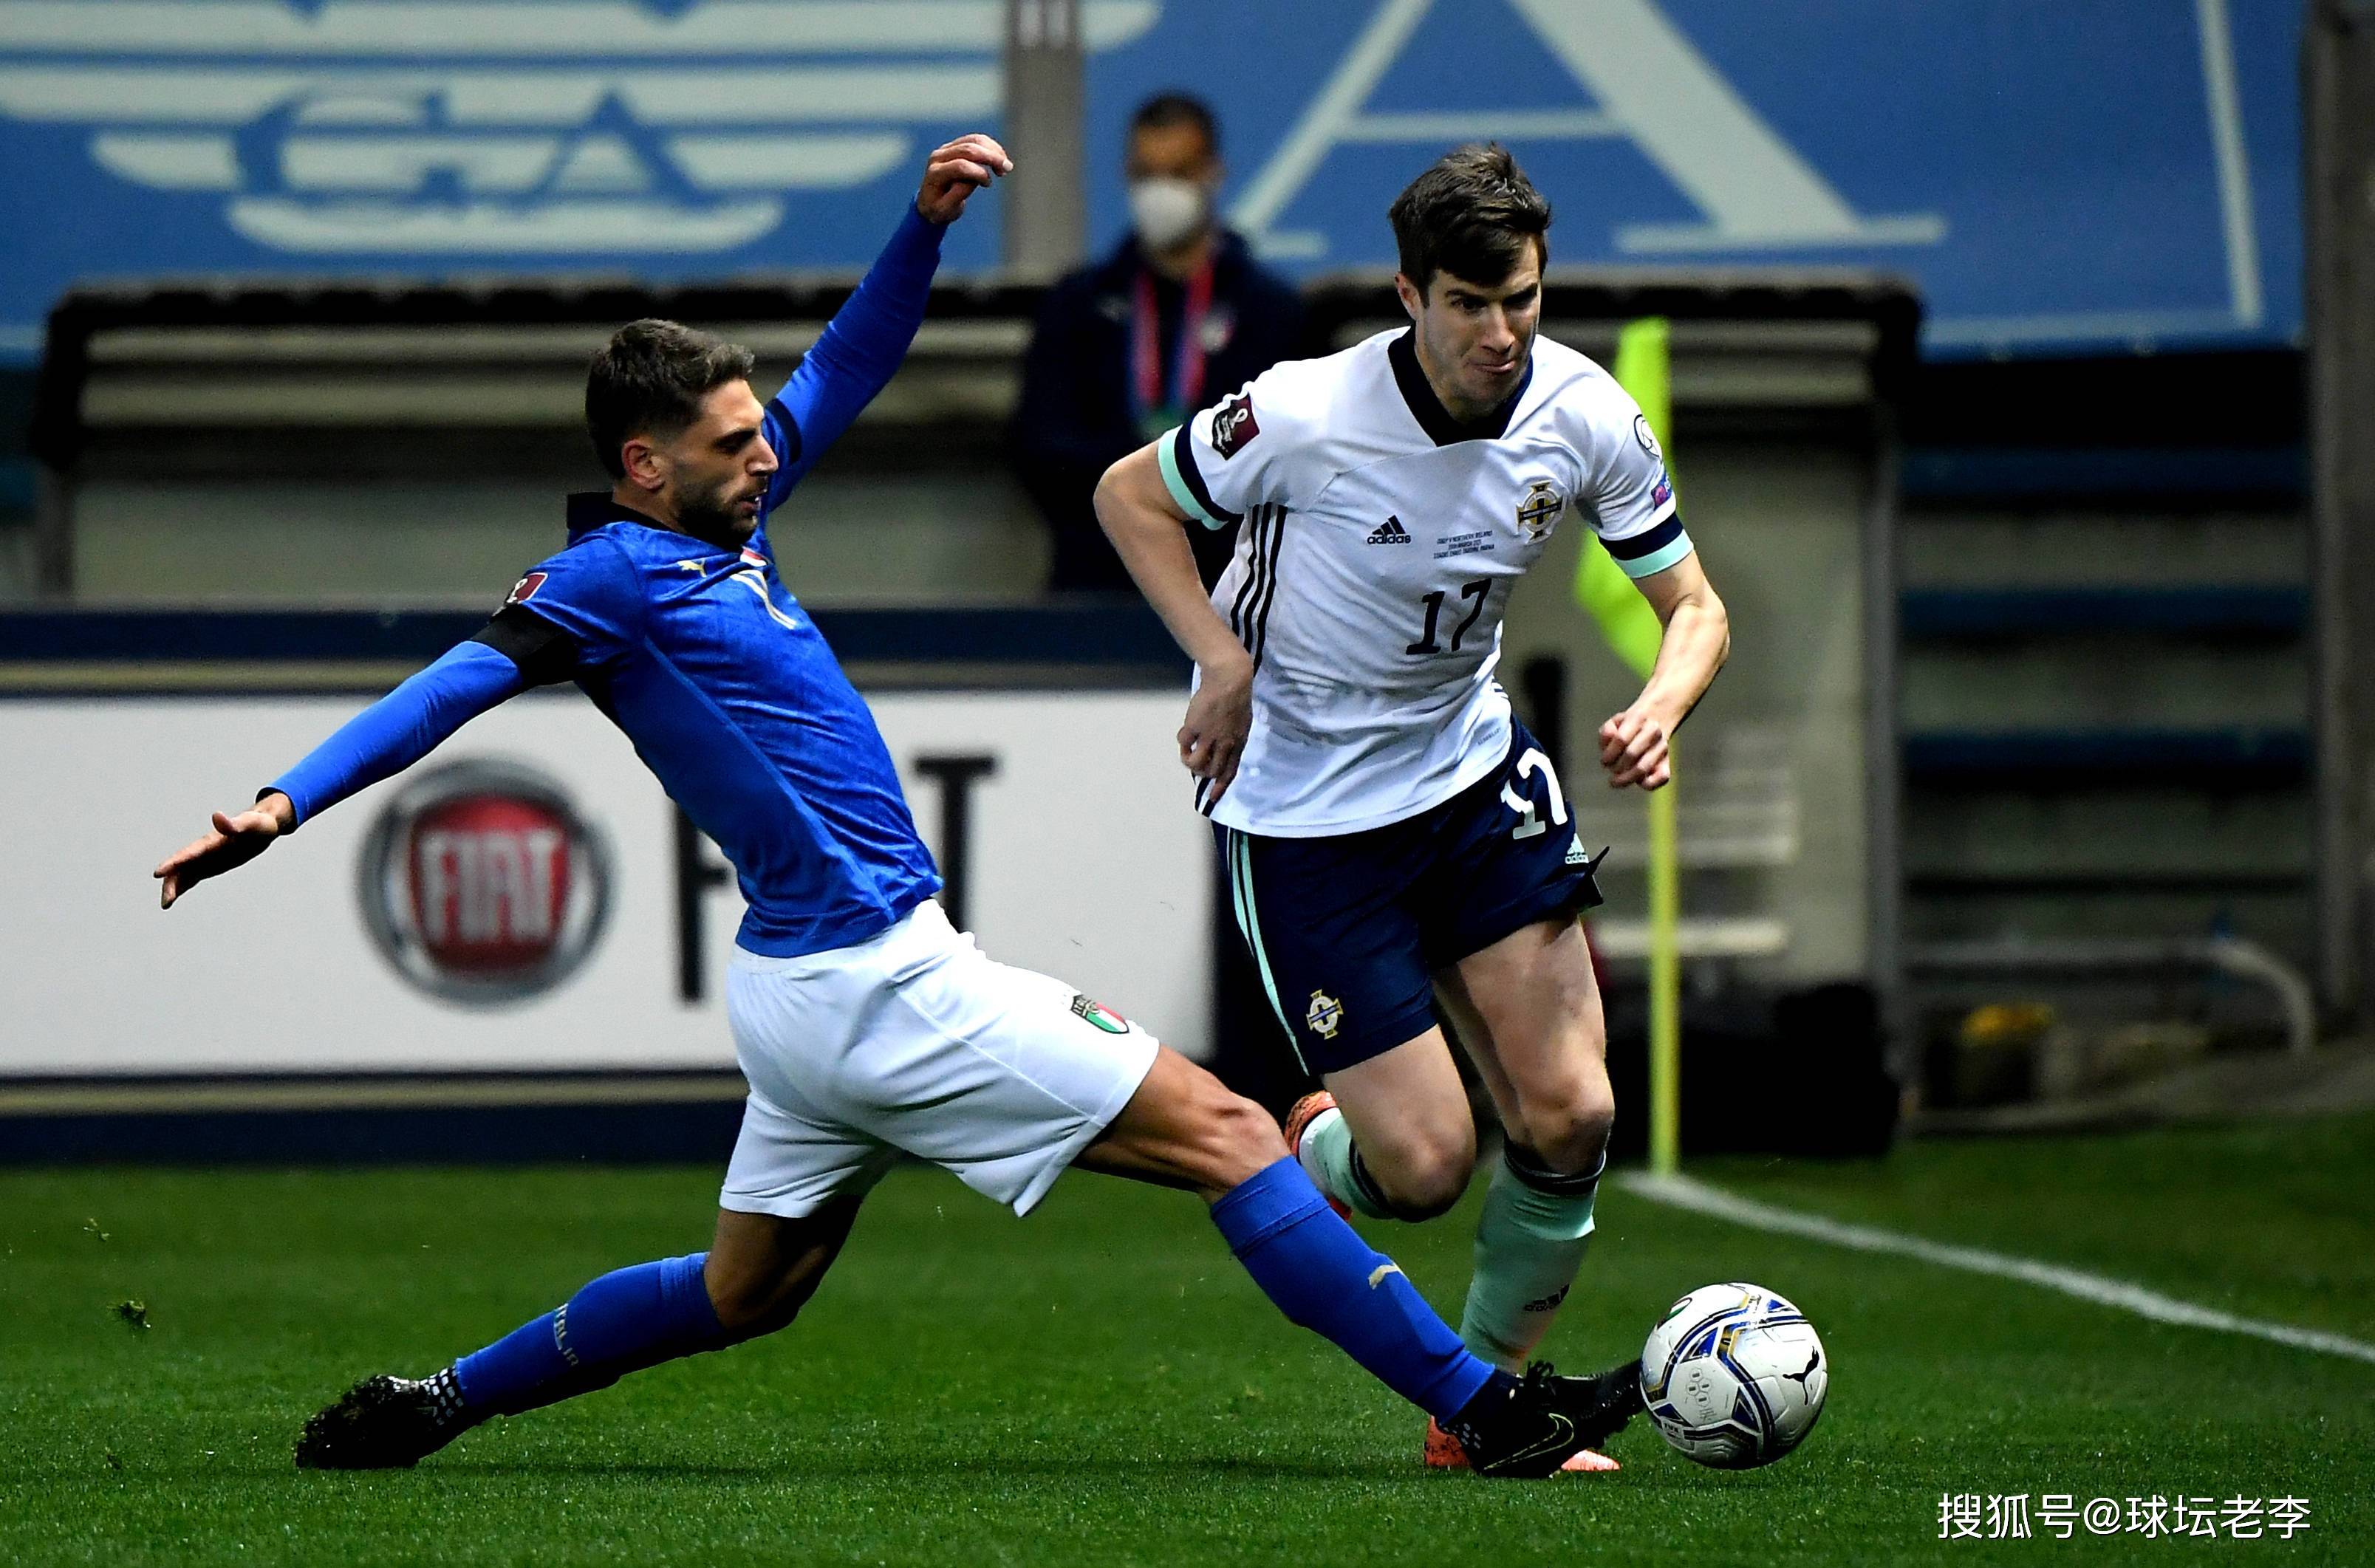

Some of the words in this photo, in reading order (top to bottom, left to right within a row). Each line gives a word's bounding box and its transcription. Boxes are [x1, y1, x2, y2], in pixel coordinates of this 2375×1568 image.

[1367, 534, 1411, 544] adidas
[1406, 578, 1492, 656] 17
[1500, 747, 1568, 840] 17
[418, 829, 561, 944] FIAT
